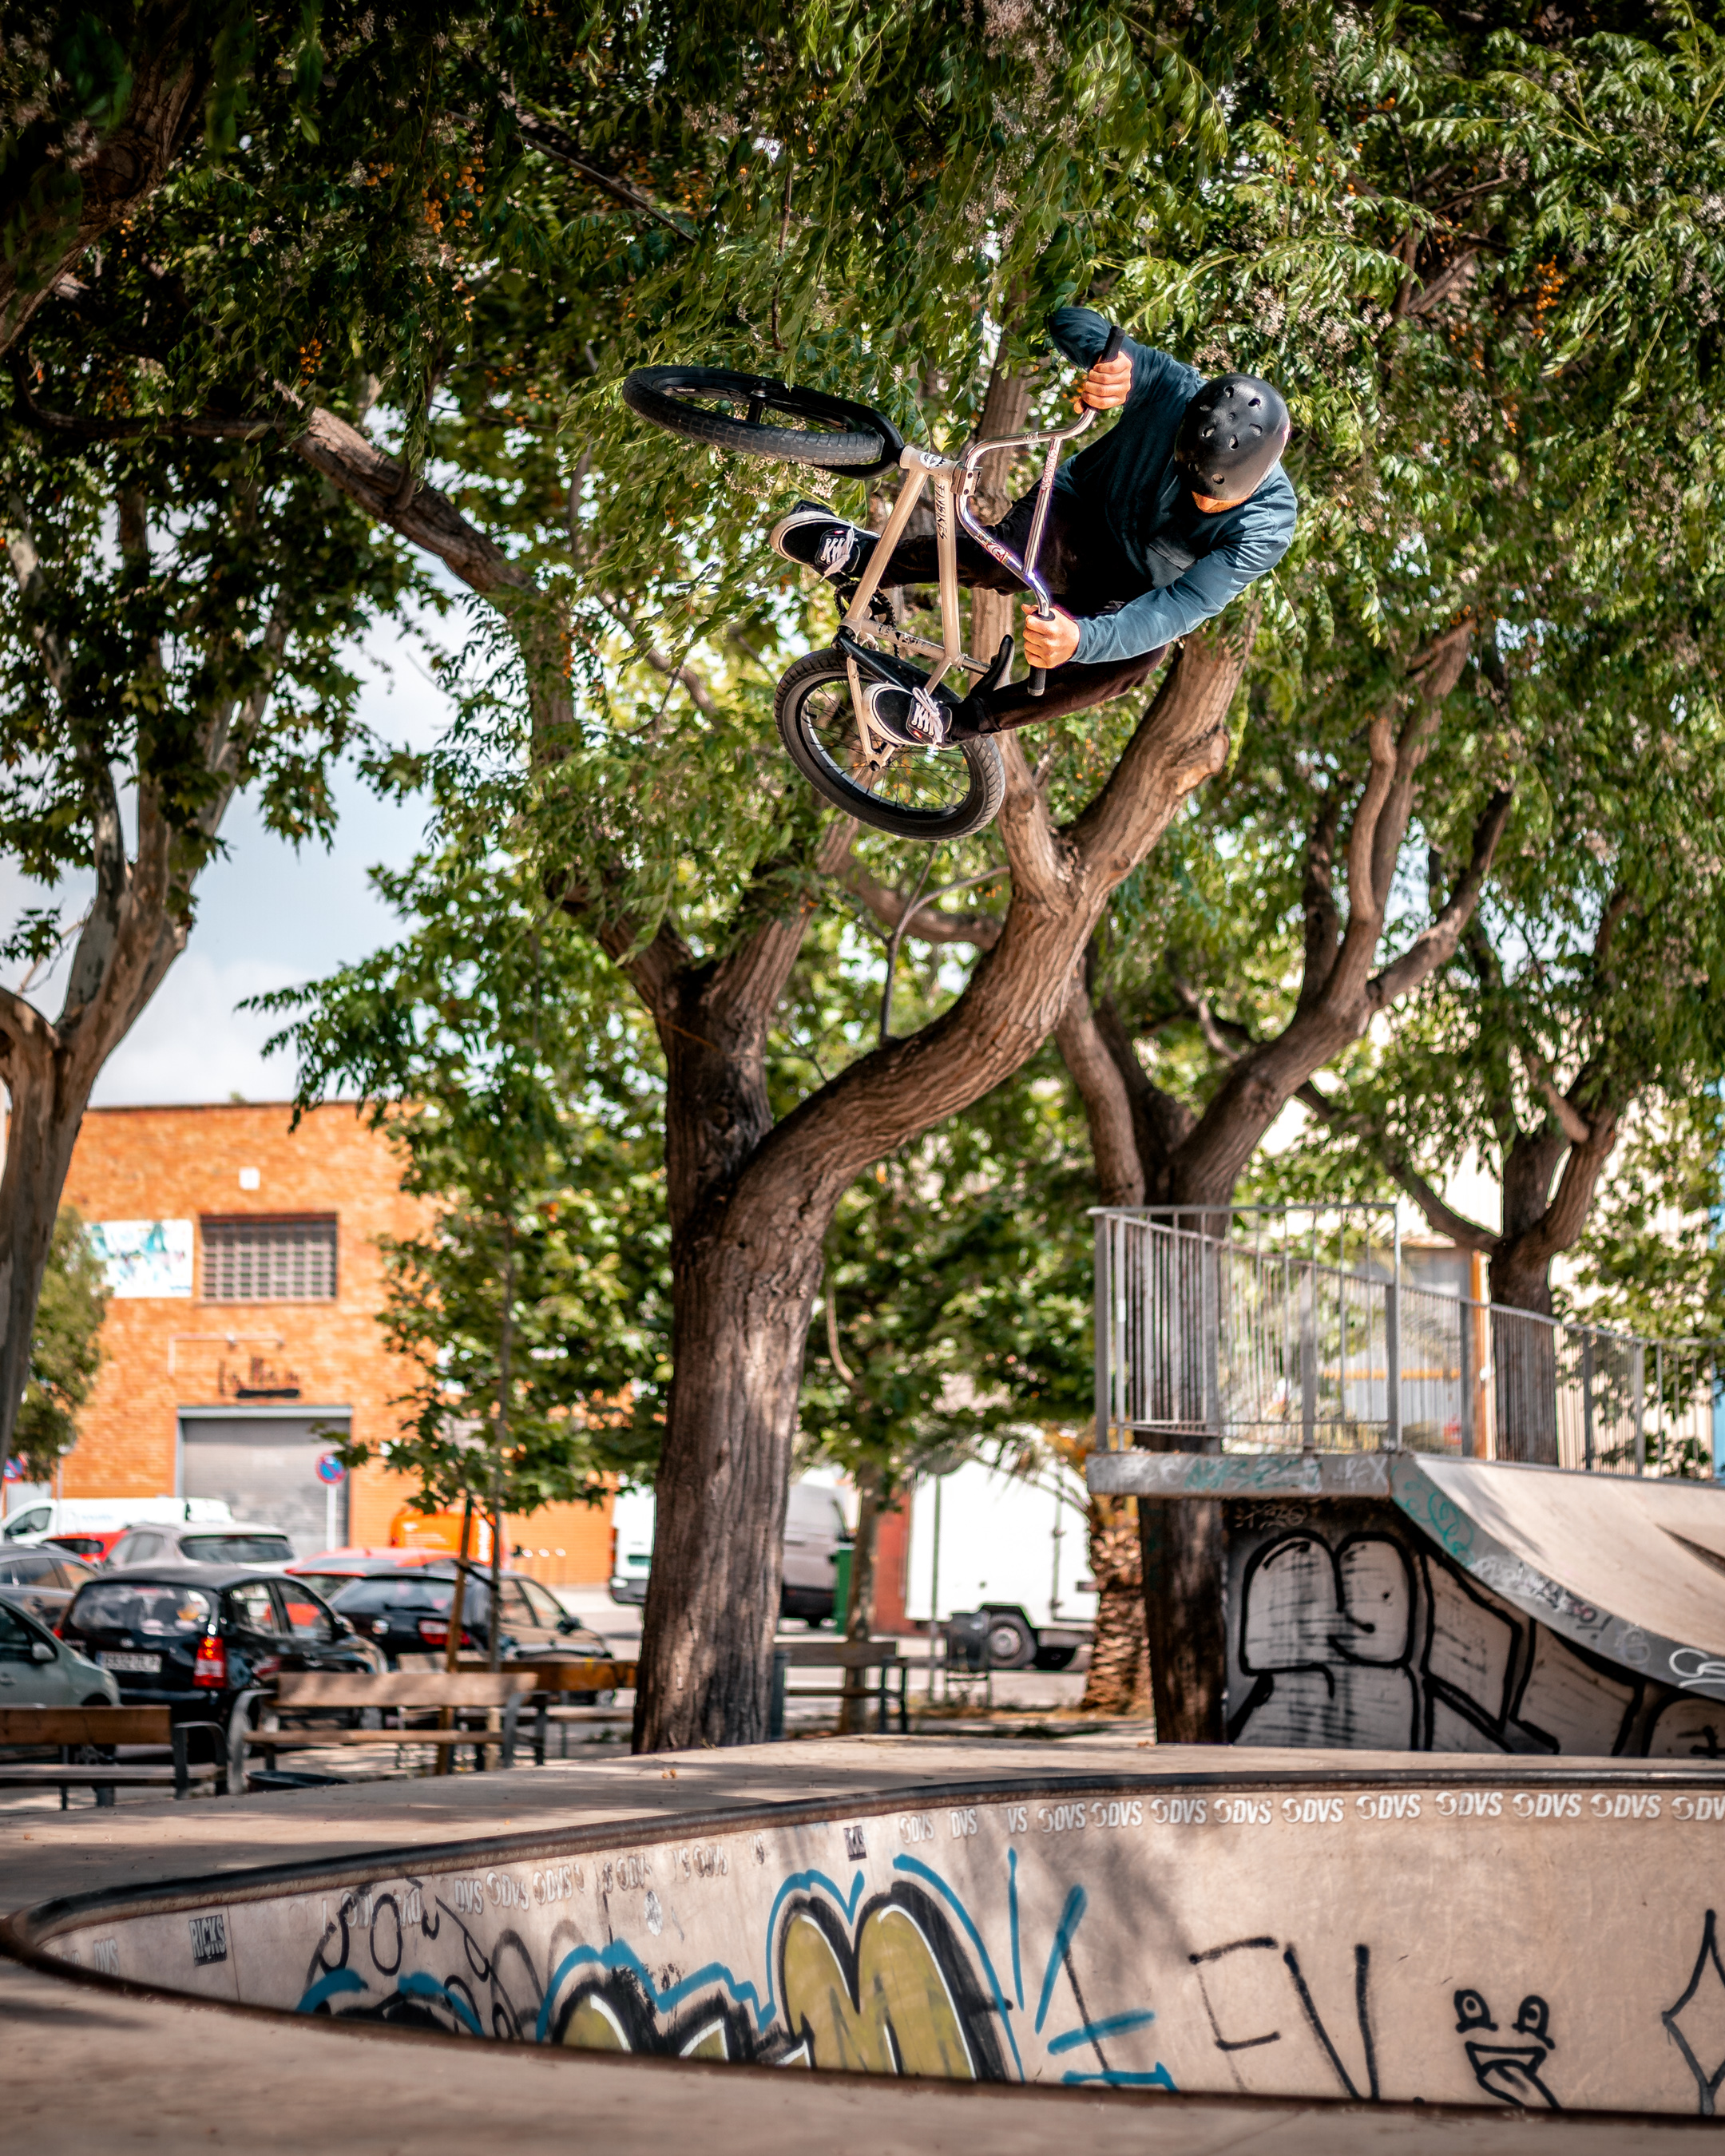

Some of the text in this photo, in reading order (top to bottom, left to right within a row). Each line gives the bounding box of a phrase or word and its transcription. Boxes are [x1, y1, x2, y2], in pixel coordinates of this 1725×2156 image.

[950, 1808, 978, 1837] DVS
[1054, 1803, 1087, 1832] DVS
[1108, 1801, 1144, 1826] DVS
[1168, 1799, 1208, 1824] DVS
[1232, 1799, 1273, 1825] DVS
[1302, 1798, 1345, 1823] DVS
[1378, 1793, 1422, 1820] DVS
[1458, 1792, 1505, 1817] DVS
[1535, 1792, 1583, 1818] DVS
[1614, 1793, 1663, 1819] DVS
[1695, 1796, 1725, 1821] DV
[454, 1879, 484, 1914] DVS
[188, 1916, 227, 1959] RICKS
